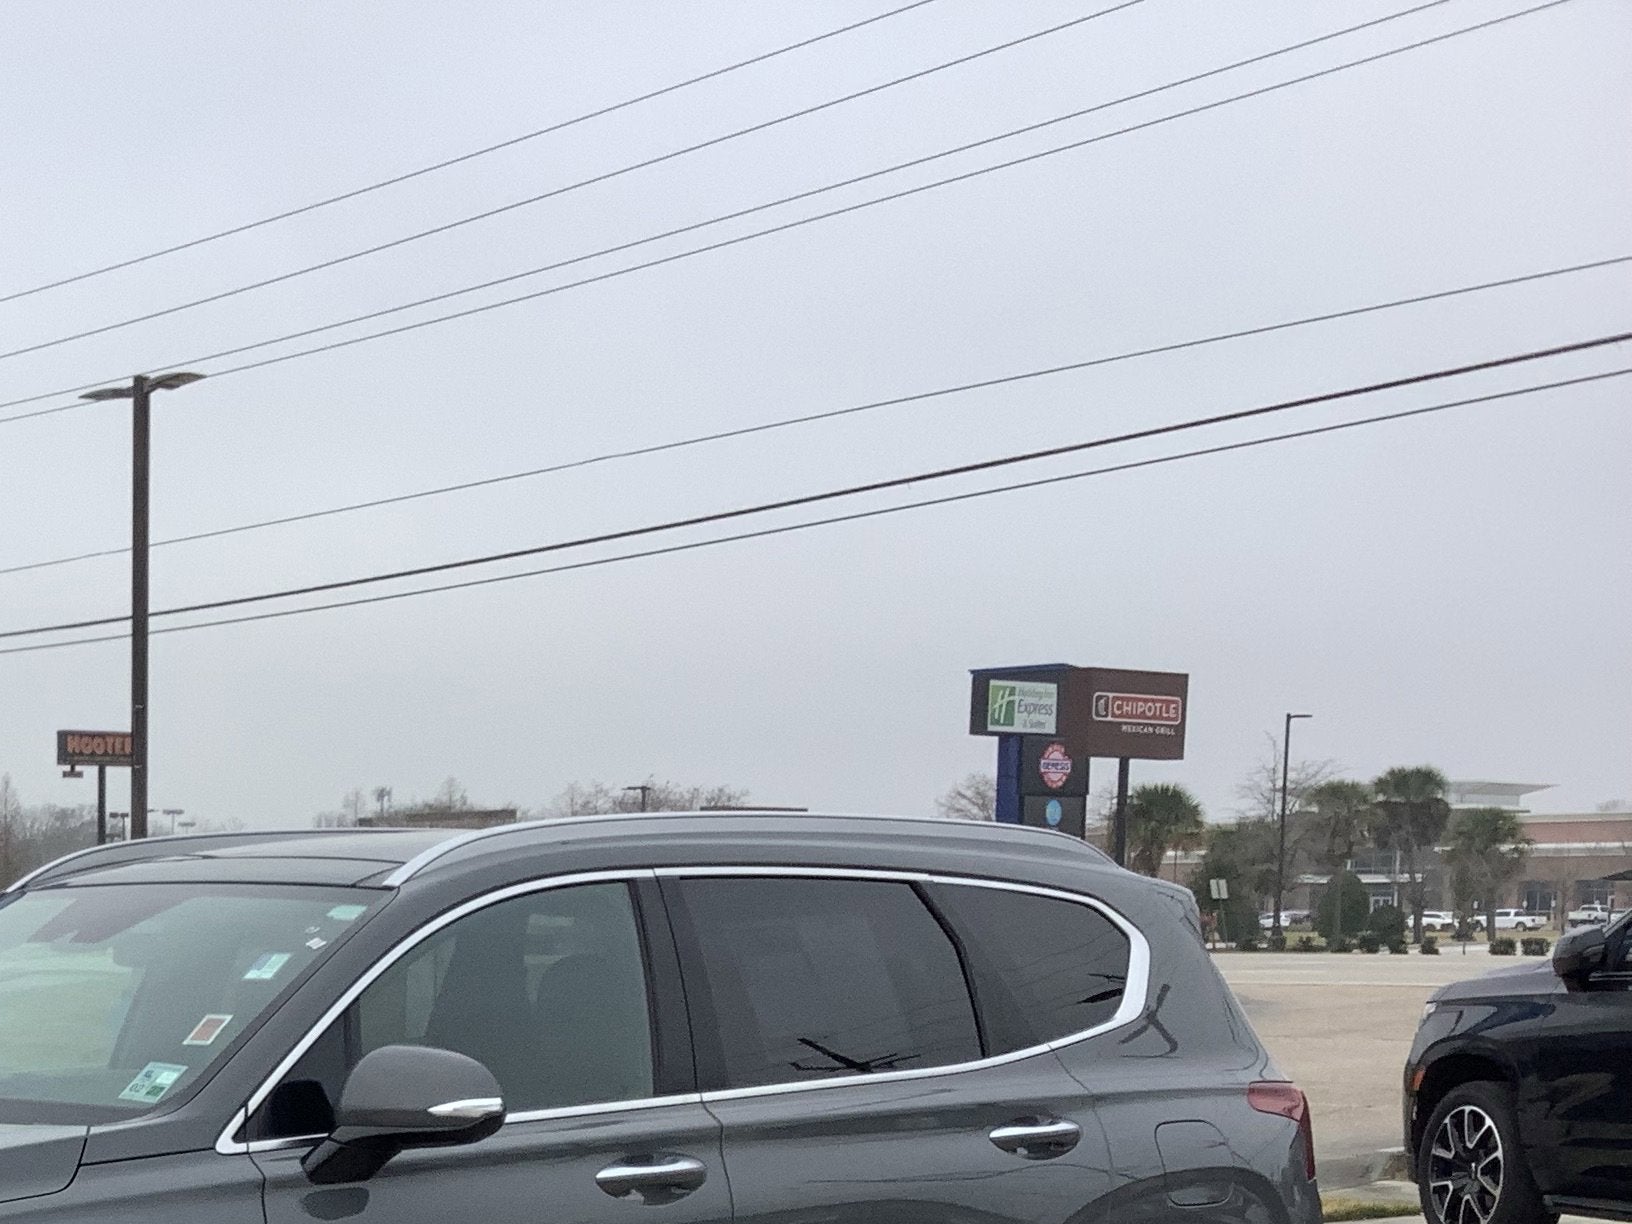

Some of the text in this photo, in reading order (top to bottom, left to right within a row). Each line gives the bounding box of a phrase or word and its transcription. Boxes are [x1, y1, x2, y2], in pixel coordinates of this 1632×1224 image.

[1017, 698, 1054, 718] Express
[1113, 700, 1177, 718] CHIPOTLE
[1121, 724, 1154, 734] MEXICAN
